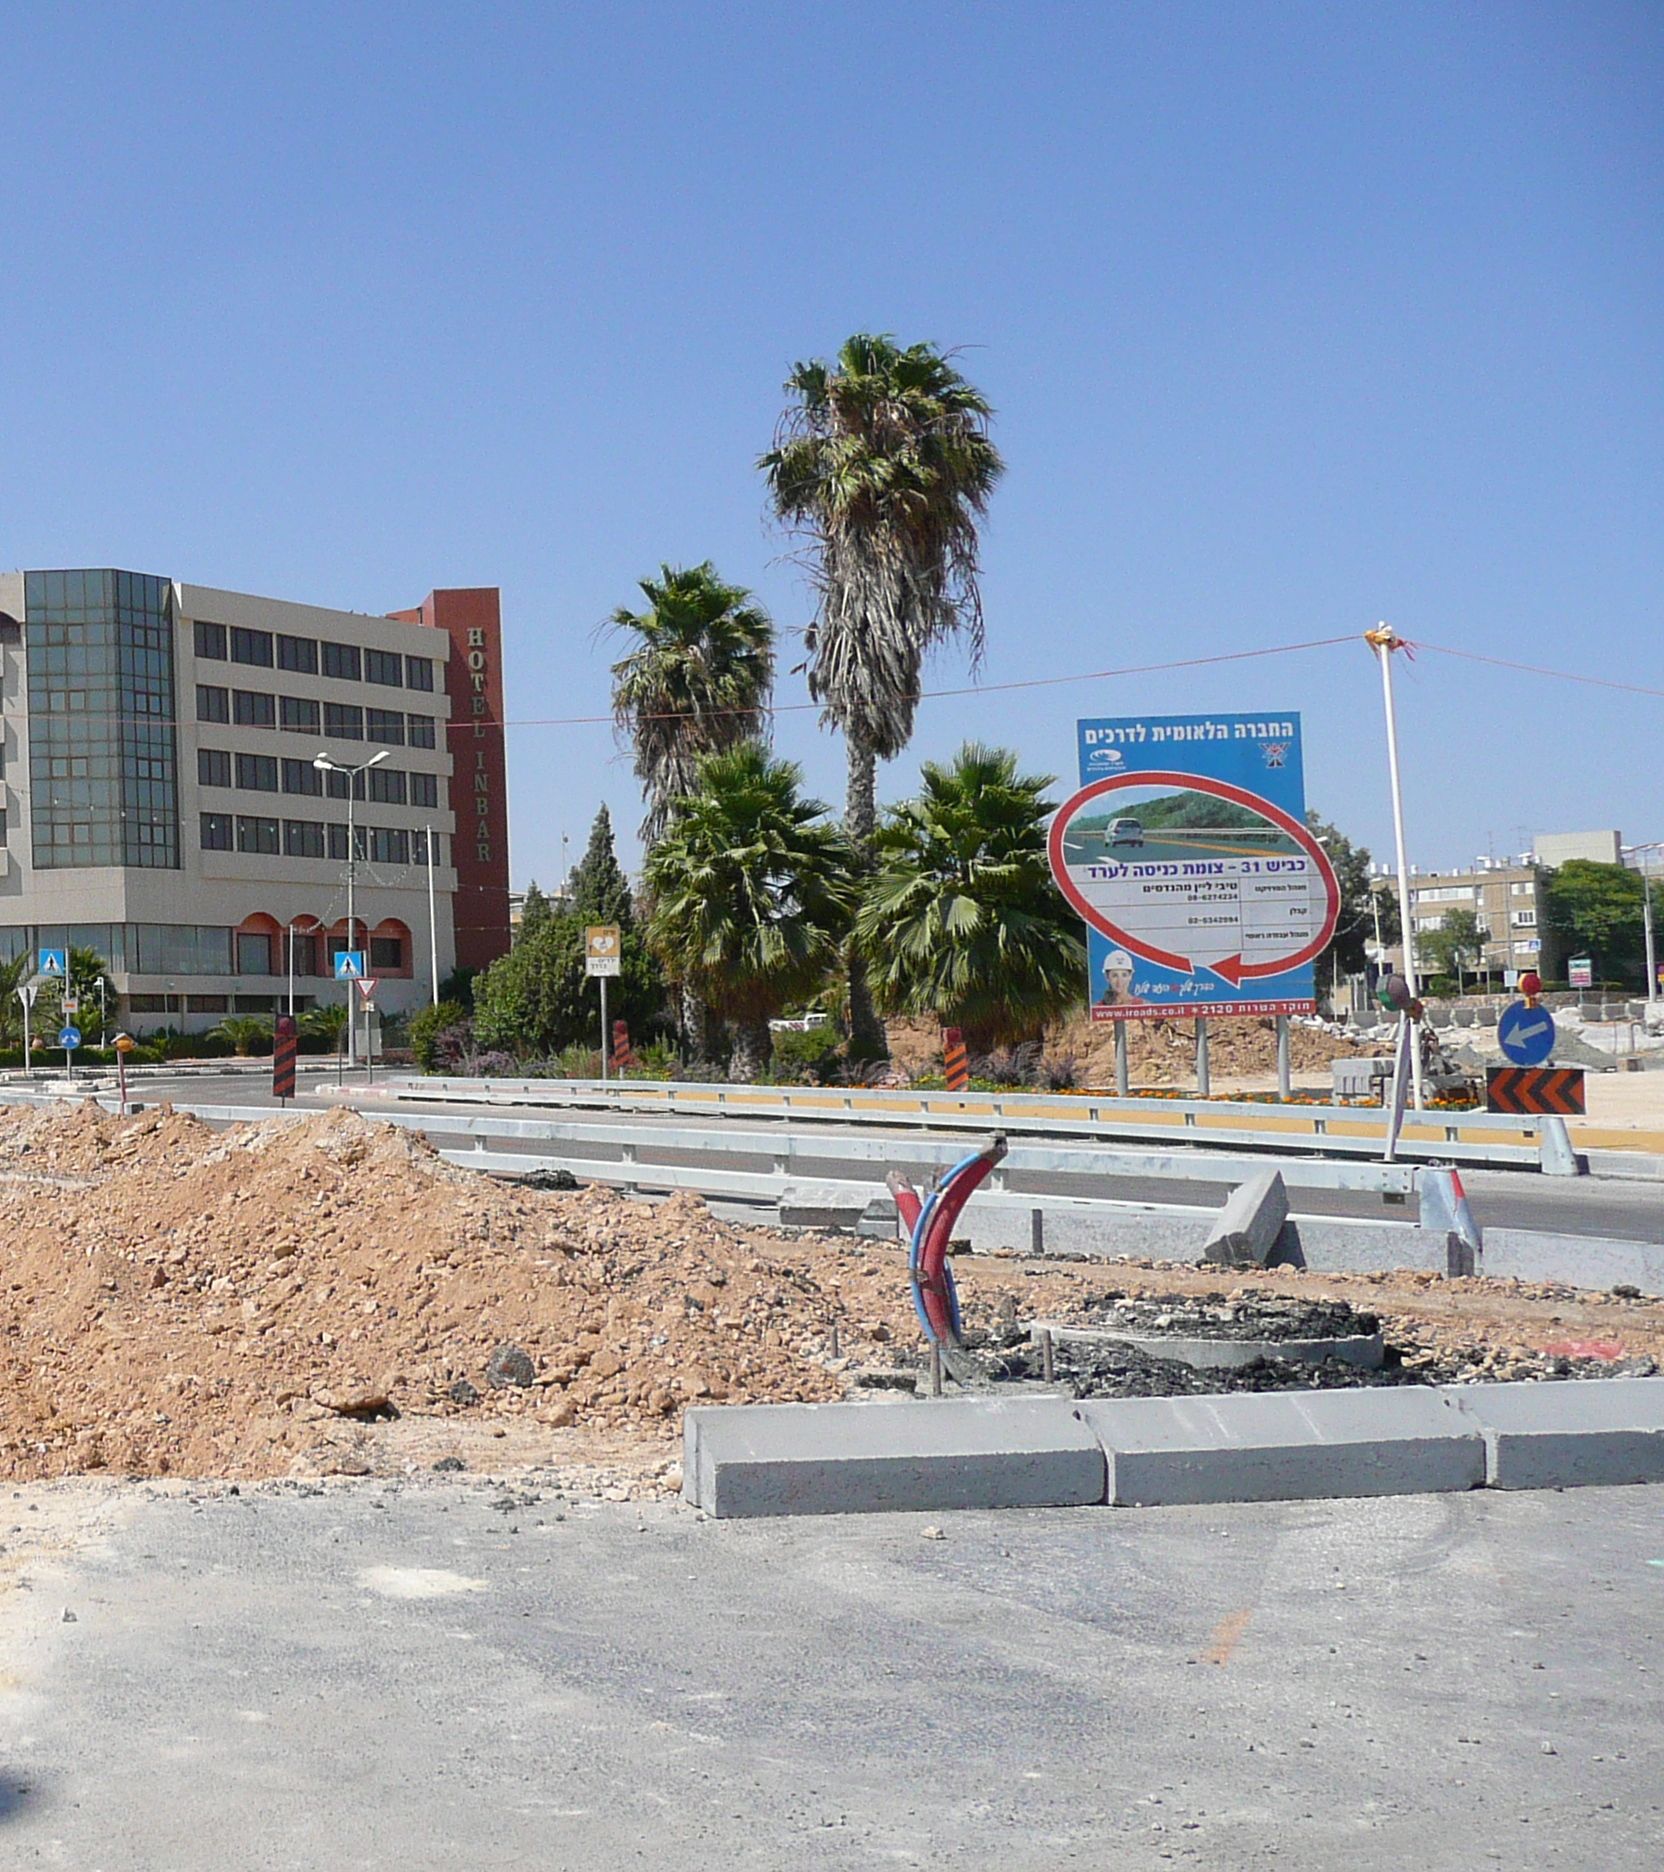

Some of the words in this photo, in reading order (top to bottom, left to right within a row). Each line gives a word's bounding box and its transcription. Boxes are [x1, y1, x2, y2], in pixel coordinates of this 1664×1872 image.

[467, 627, 485, 738] HOTEL
[1085, 724, 1147, 744] לדרכים
[1151, 721, 1229, 742] הלאומית
[1234, 722, 1294, 738] החברה
[473, 751, 492, 862] INBAR
[1087, 863, 1129, 879] לערד
[1133, 865, 1179, 877] כניסה
[1182, 862, 1224, 875] צומת
[1241, 861, 1261, 873] 31
[1266, 859, 1306, 872] כביש
[1143, 884, 1191, 893] מהנדסים
[1095, 1006, 1185, 1019] www.iroads.co.il
[1282, 1002, 1310, 1012] מוקד
